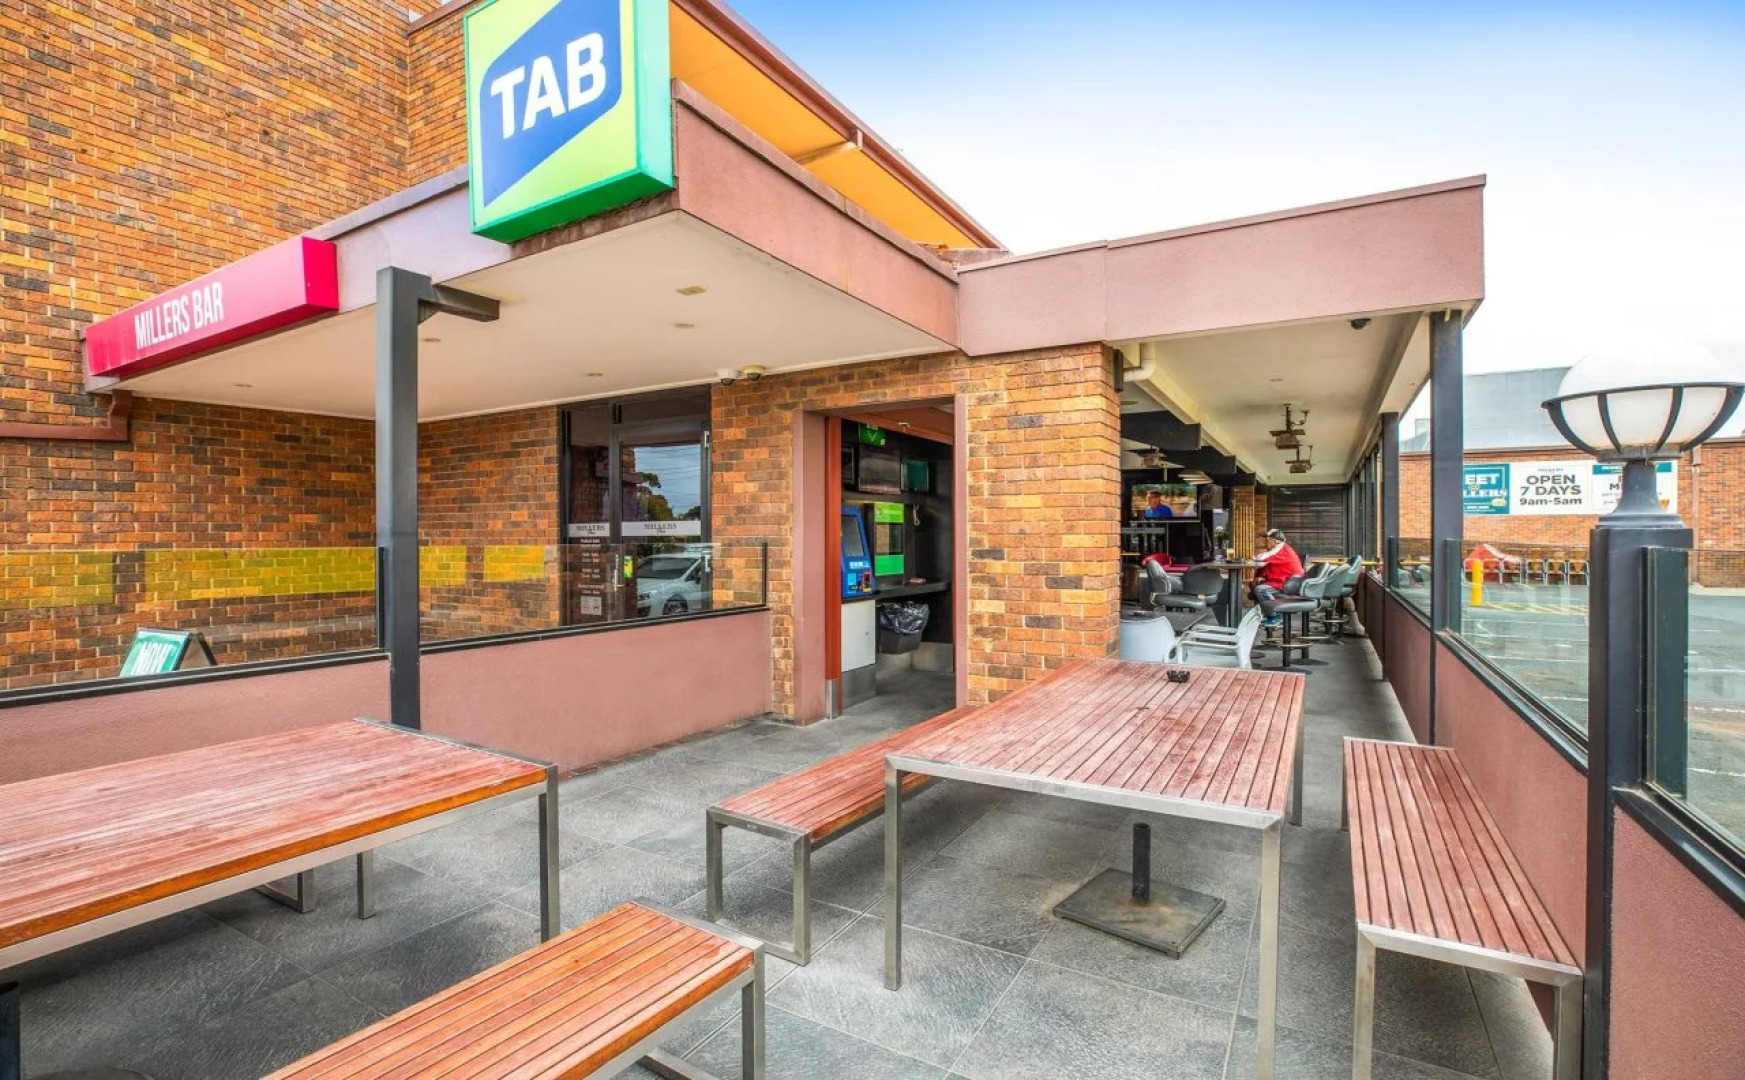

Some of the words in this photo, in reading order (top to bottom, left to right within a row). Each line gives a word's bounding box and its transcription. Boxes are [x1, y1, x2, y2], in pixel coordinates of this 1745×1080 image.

[490, 32, 606, 140] TAB
[134, 295, 191, 350] MILLERS
[191, 281, 224, 330] BAR
[1464, 473, 1500, 485] EET
[1526, 474, 1576, 485] OPEN
[1463, 489, 1508, 498] LLERS
[1520, 486, 1530, 496] 7
[1535, 485, 1582, 495] DAYS
[1519, 497, 1582, 506] 9am-5am
